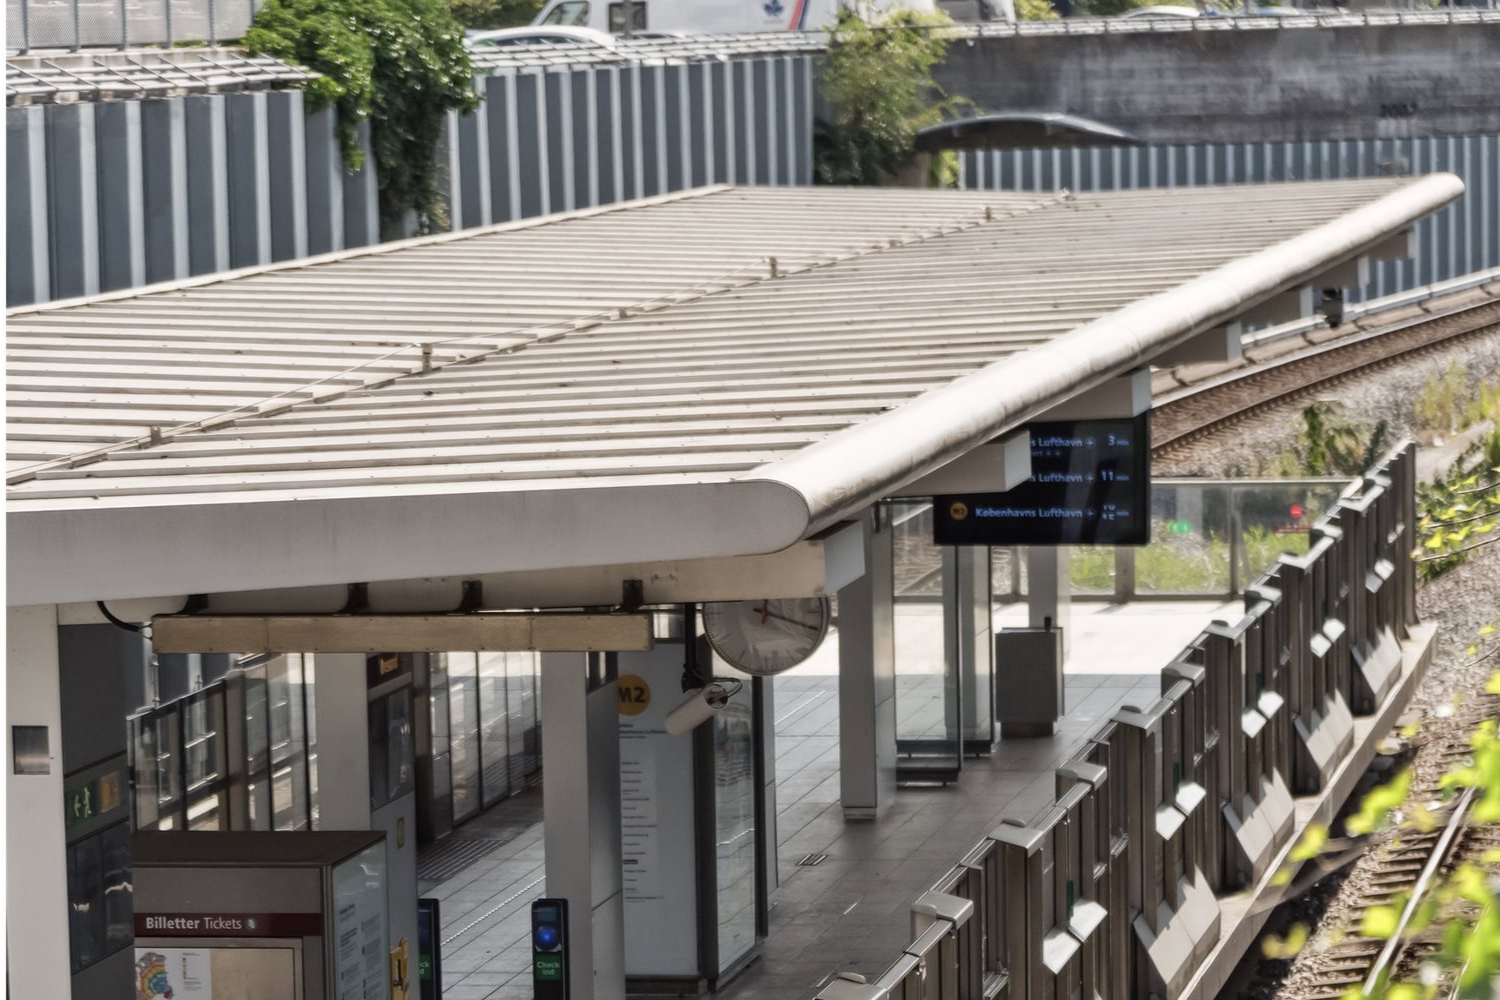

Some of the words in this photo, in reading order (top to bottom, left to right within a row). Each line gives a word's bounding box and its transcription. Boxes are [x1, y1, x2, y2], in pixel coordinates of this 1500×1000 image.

[1038, 437, 1083, 447] Lufthavn
[1107, 435, 1116, 446] 3
[1038, 472, 1083, 482] Lufthavn
[1101, 470, 1114, 481] 11
[975, 507, 1036, 518] Københavns
[1038, 507, 1083, 518] Lufthavn
[617, 687, 646, 703] M2
[145, 916, 200, 930] Billetter
[203, 916, 242, 930] Tickets
